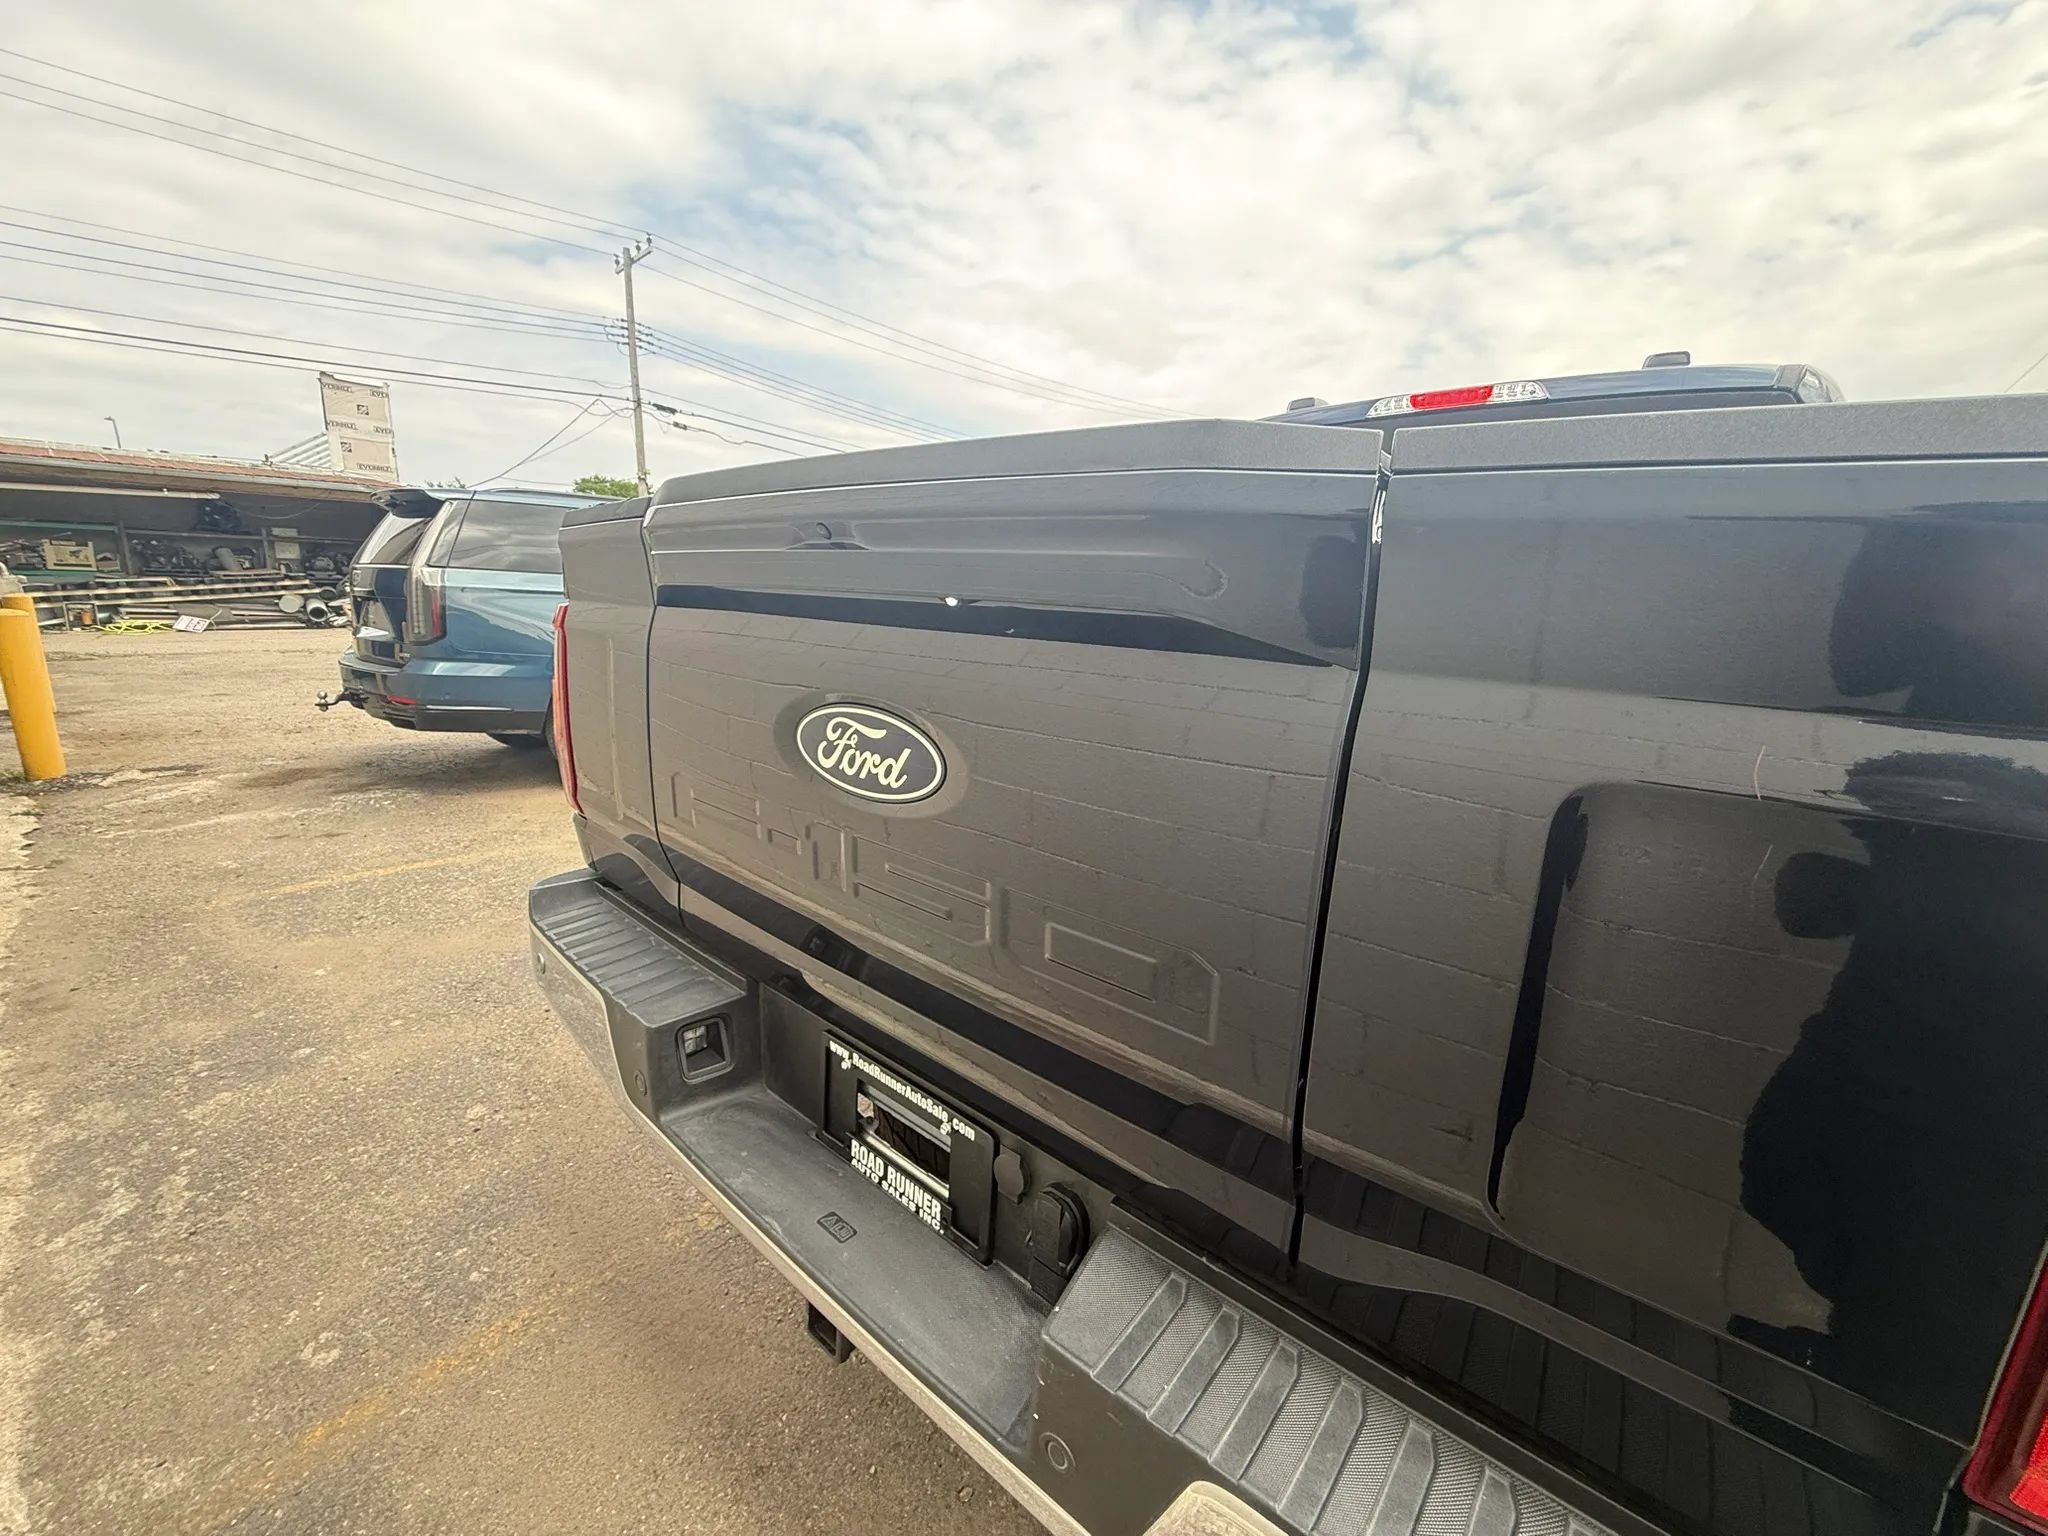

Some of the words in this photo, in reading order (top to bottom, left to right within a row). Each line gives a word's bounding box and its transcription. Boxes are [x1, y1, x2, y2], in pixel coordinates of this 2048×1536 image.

[817, 716, 912, 788] Ford
[671, 770, 1219, 1045] F-150
[850, 1139, 884, 1177] ROAD
[887, 1165, 941, 1221] RUNNER
[851, 1158, 879, 1183] AUTO
[881, 1180, 916, 1211] SALES
[919, 1208, 944, 1234] INC.
